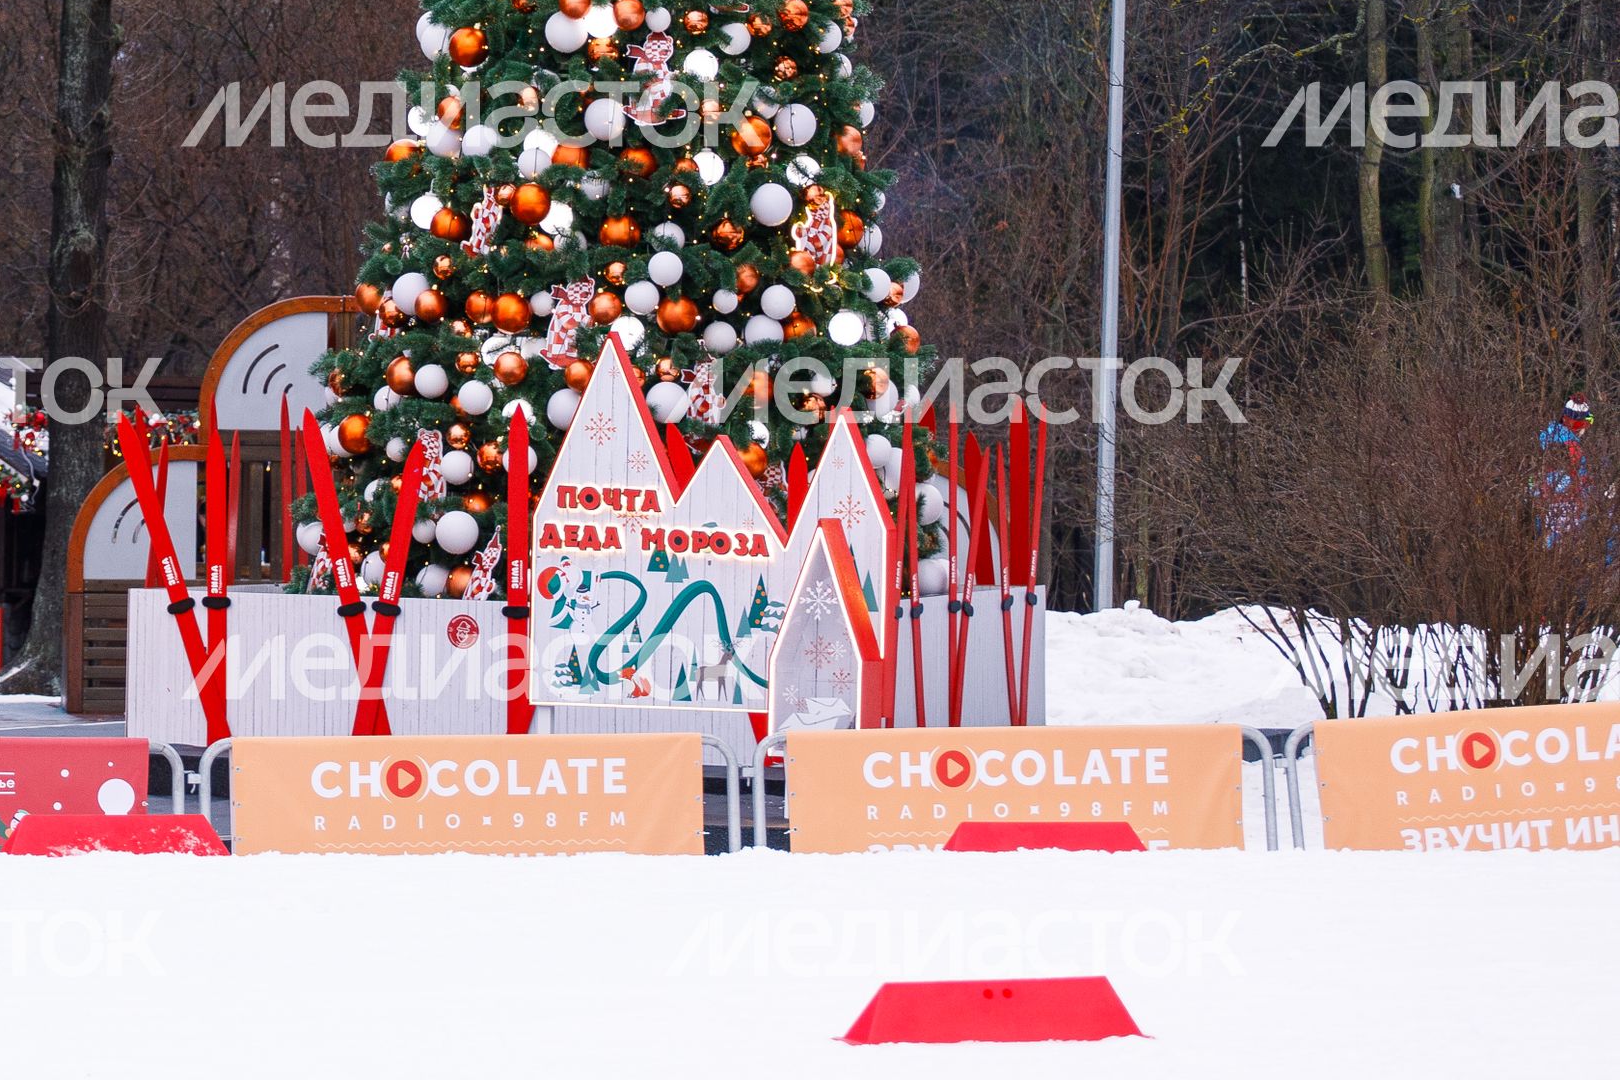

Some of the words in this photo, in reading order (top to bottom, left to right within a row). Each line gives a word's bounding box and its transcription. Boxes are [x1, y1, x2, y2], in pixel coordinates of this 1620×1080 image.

[556, 485, 661, 513] ПОЧТА
[539, 523, 622, 552] ДЕДА
[640, 527, 770, 557] МОРОЗА
[311, 756, 628, 801] CHOCOLATE
[862, 747, 1169, 790] CHOCOLATE
[1396, 781, 1536, 806] RADIO
[314, 813, 461, 831] RADIO
[867, 802, 1009, 820] RADIO
[1400, 819, 1552, 852] ЗВУЧИТ
